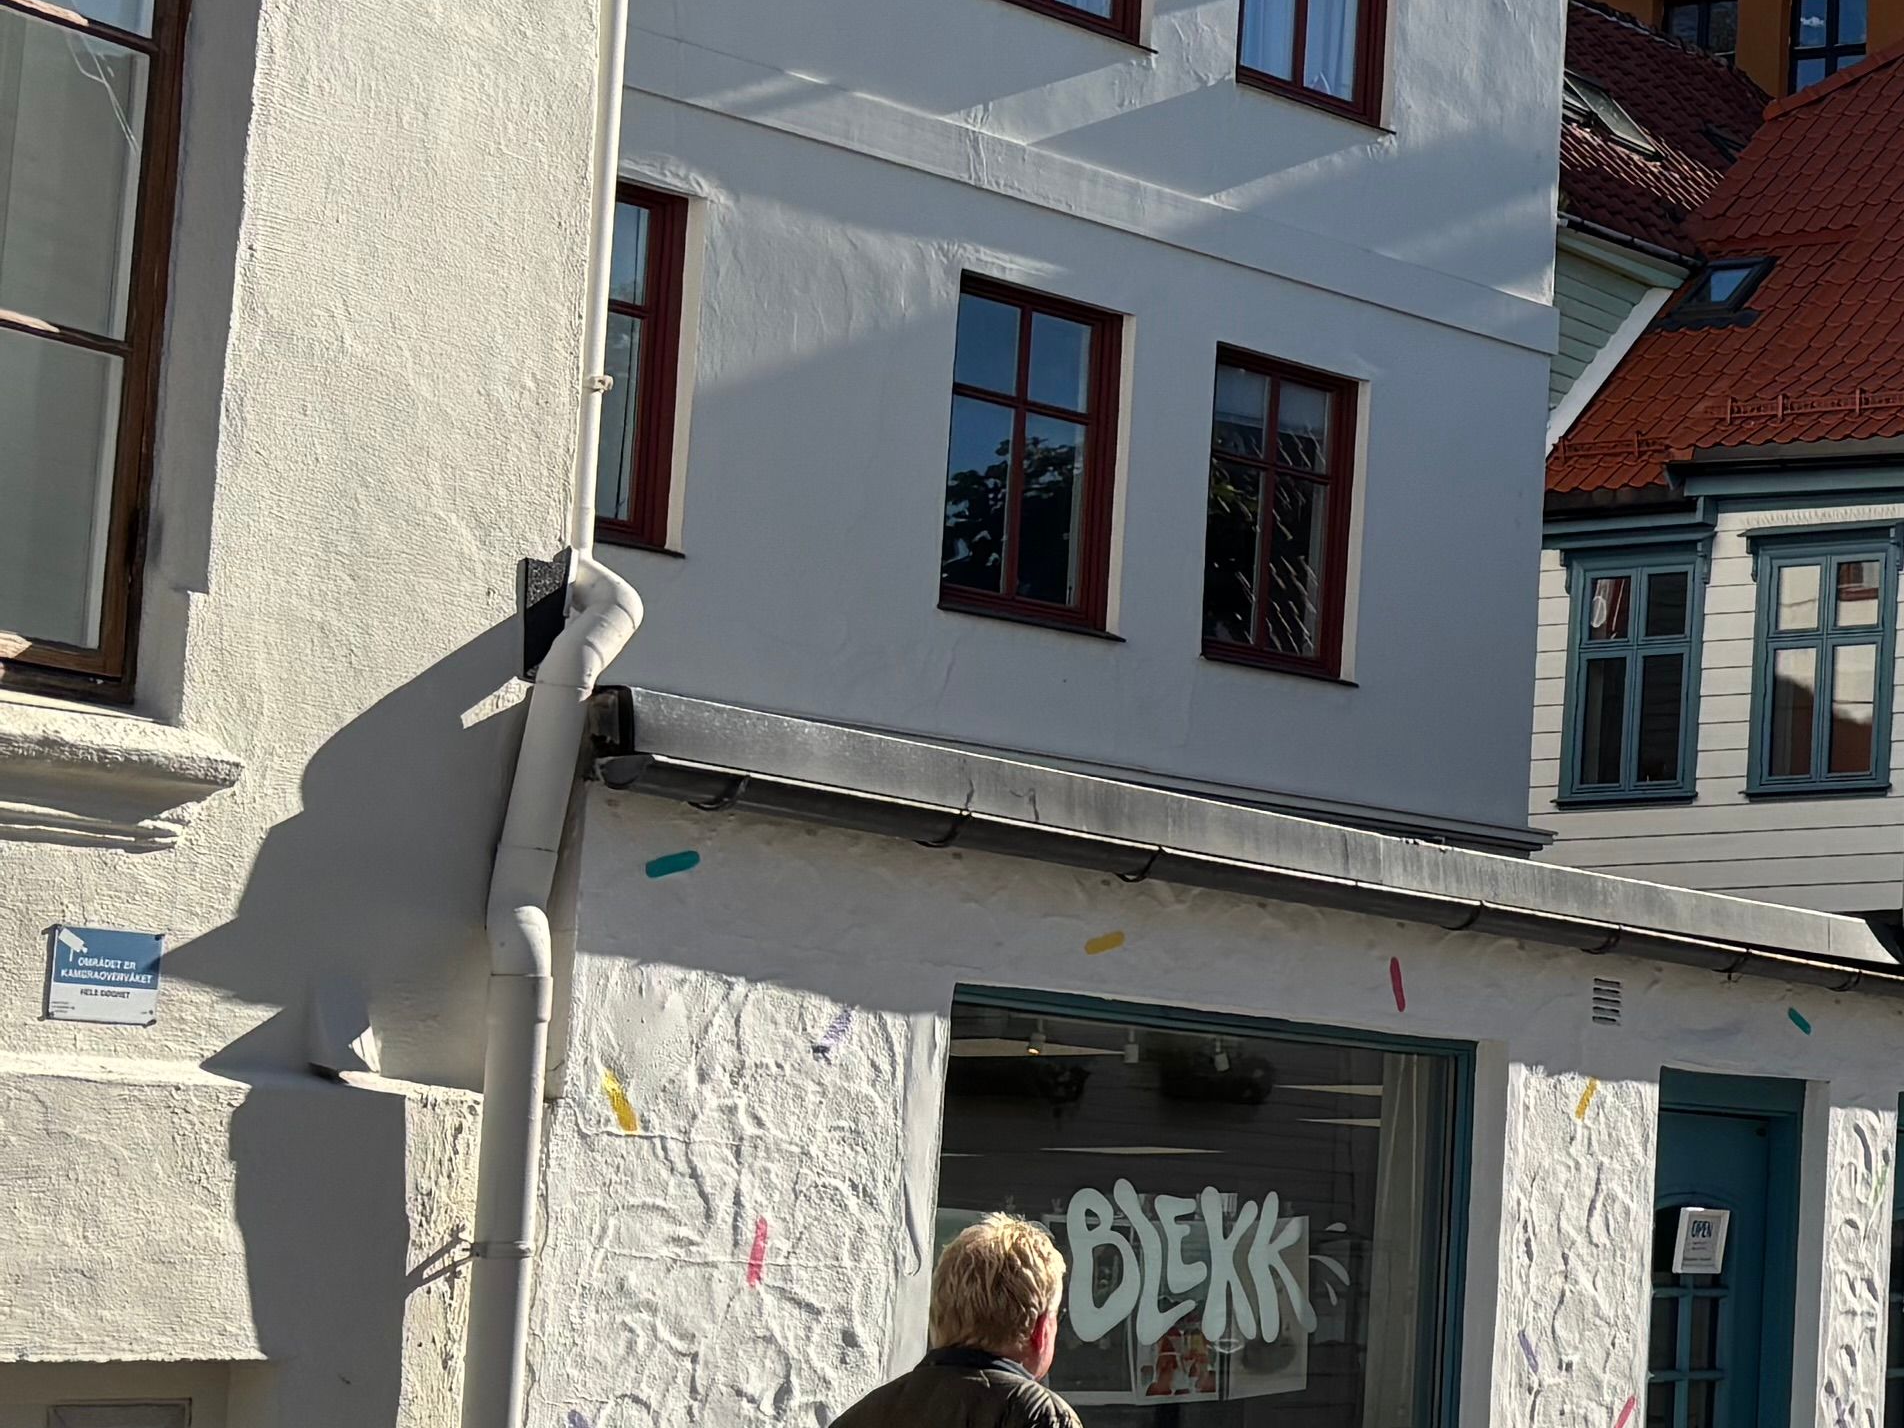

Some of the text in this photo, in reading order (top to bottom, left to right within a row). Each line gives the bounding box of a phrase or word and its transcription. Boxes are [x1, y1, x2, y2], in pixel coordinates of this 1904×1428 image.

[78, 956, 136, 970] OMRÅDET ER
[1066, 1178, 1317, 1345] BLEKK
